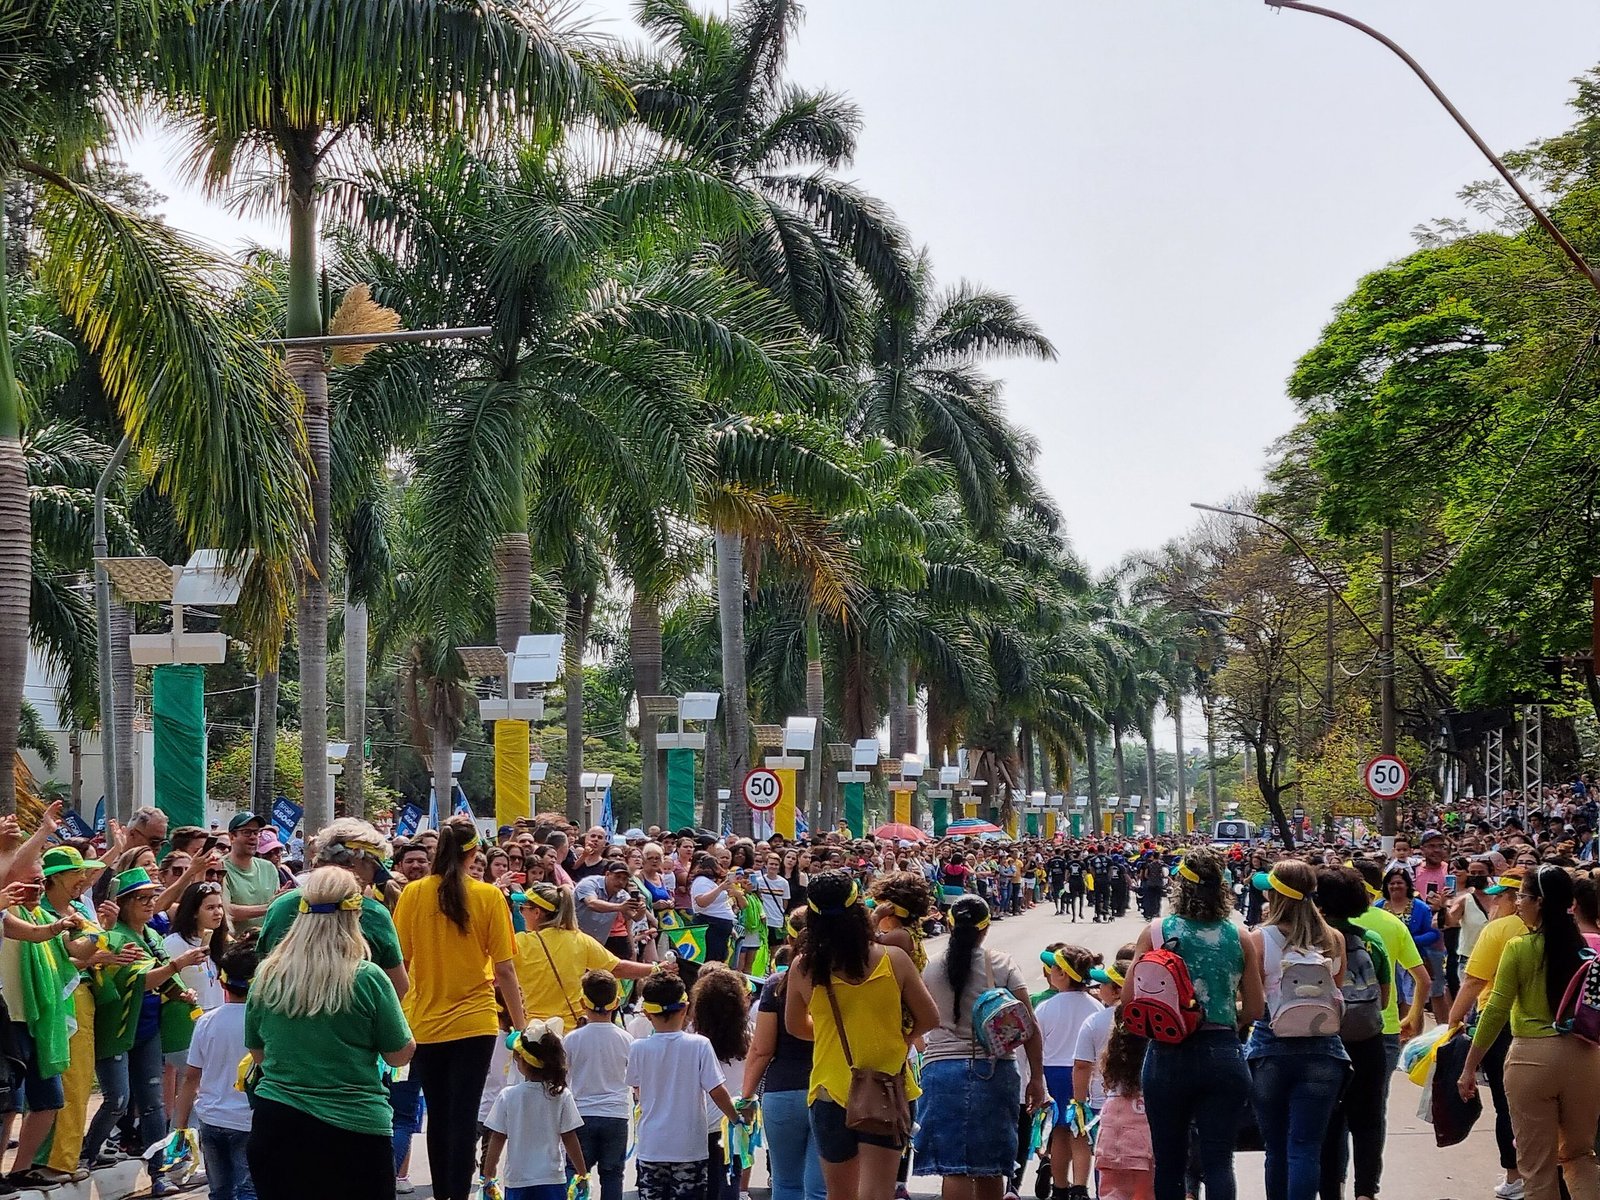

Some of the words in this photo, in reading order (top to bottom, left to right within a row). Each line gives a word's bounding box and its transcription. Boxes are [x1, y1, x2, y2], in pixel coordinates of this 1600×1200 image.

[1374, 765, 1400, 784] 50
[750, 777, 774, 797] 50
[273, 809, 295, 828] 45045
